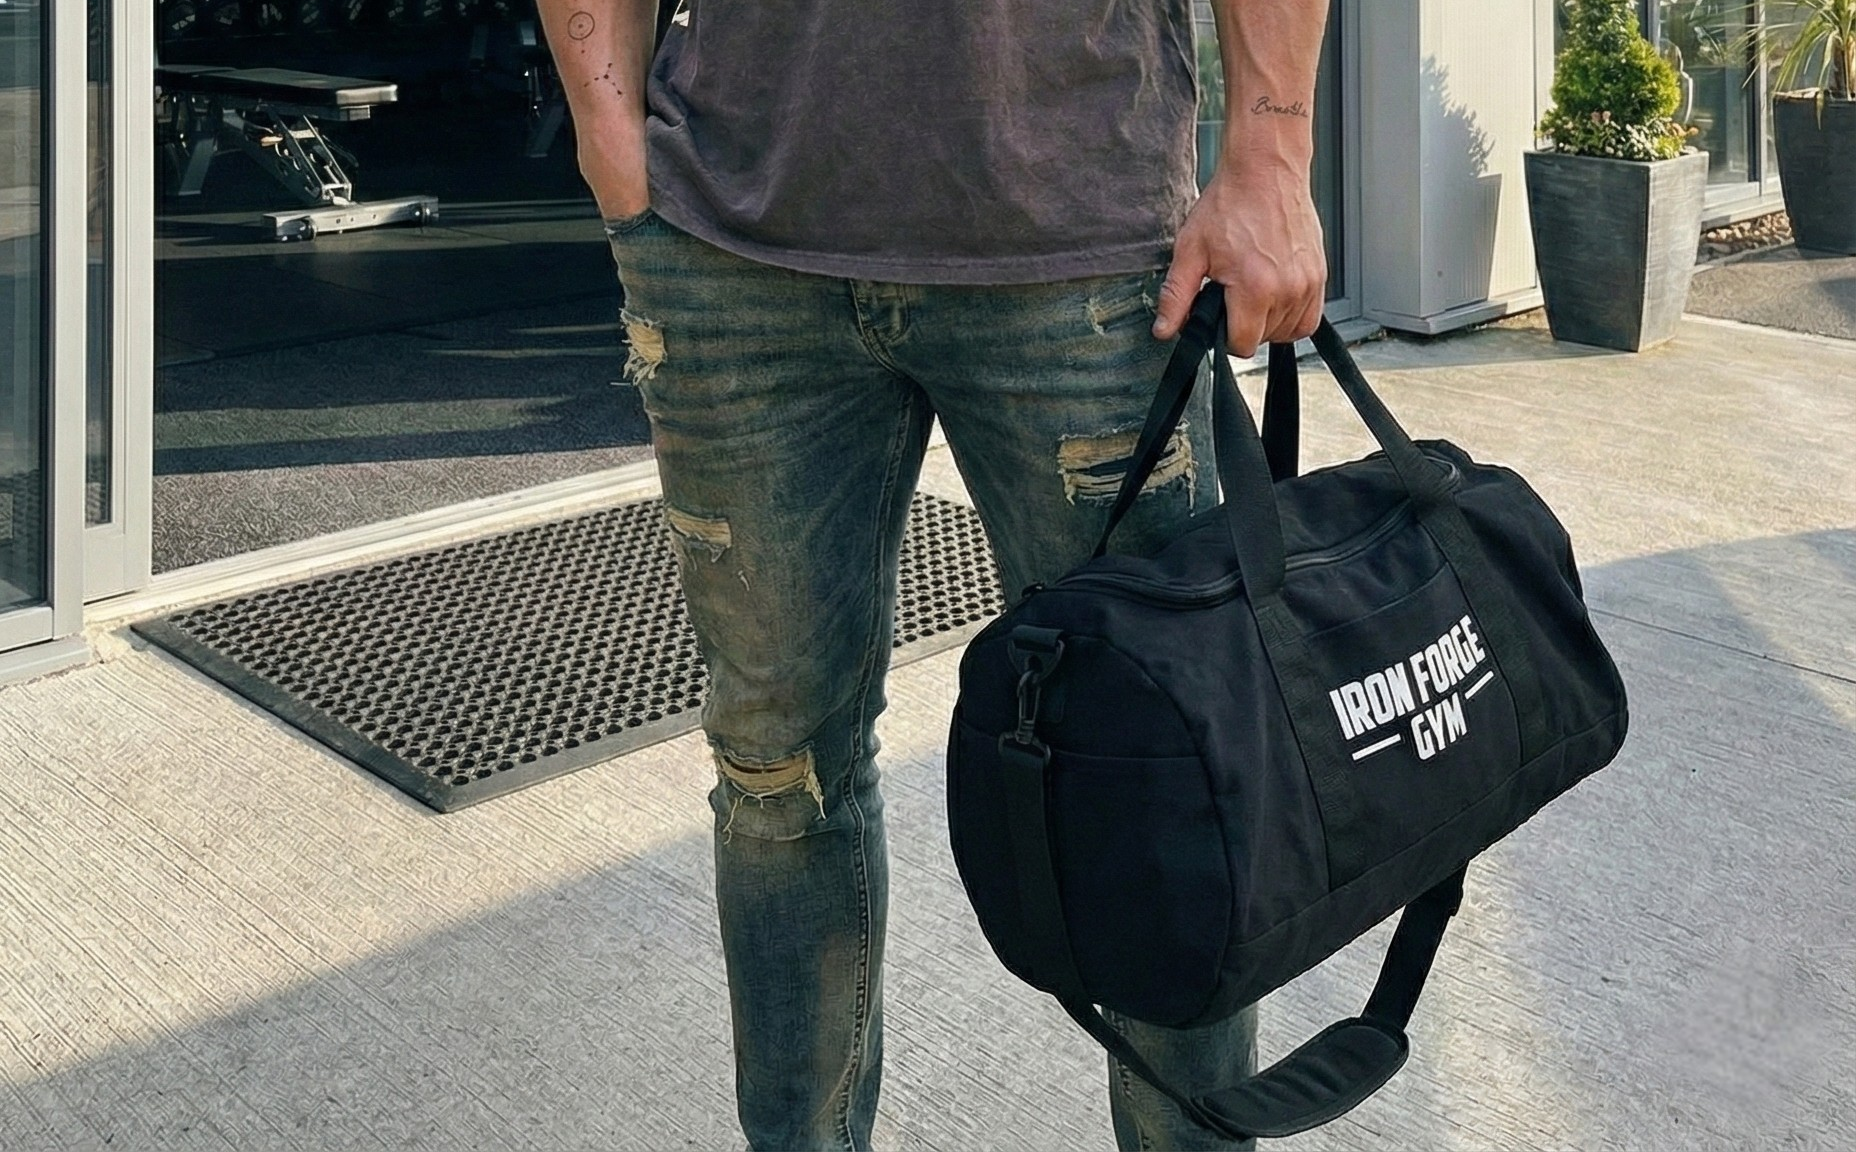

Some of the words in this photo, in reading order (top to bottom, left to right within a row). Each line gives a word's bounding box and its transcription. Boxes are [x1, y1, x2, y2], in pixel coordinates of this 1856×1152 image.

[1328, 662, 1416, 741] IRON
[1409, 614, 1486, 704] FORGE
[1410, 692, 1468, 761] GYM
